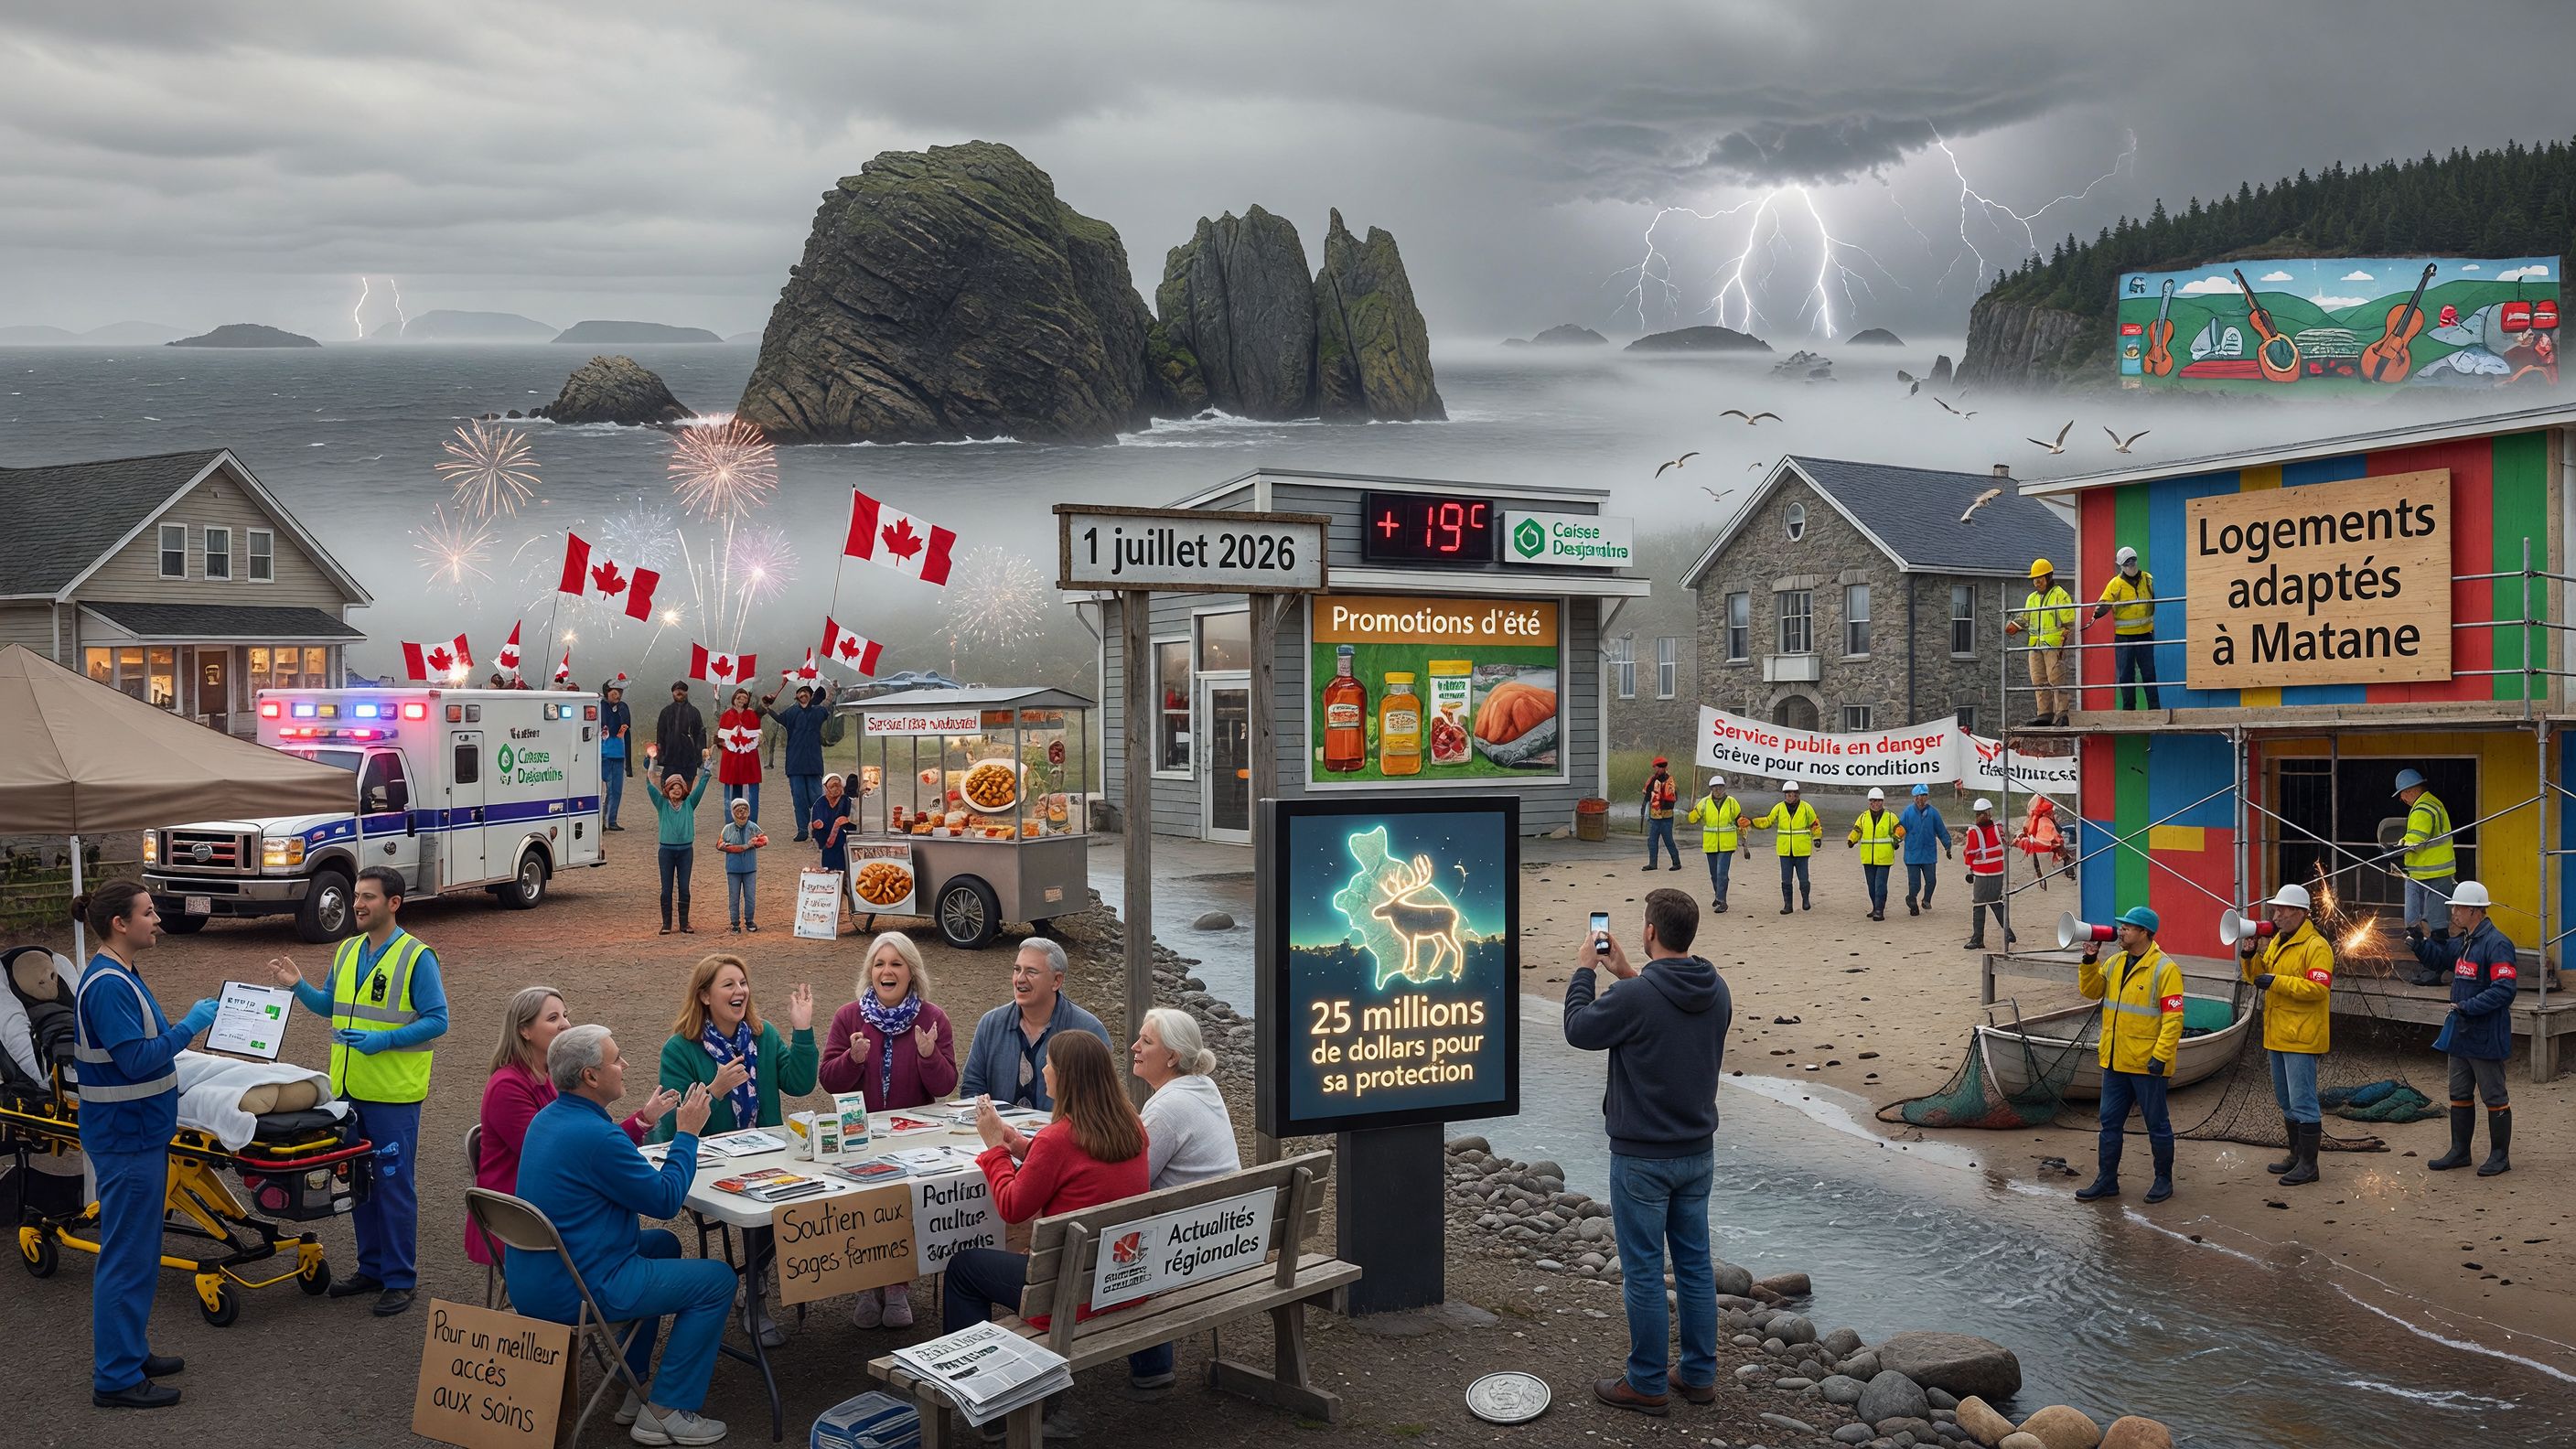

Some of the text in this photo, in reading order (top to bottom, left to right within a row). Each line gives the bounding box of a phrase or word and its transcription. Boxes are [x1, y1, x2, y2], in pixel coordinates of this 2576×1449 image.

[1084, 527, 1296, 575] 1 juillet 2026
[2199, 498, 2436, 564] Logements
[2227, 555, 2401, 617] adaptés
[1333, 606, 1540, 636] Promotions d'été
[2212, 622, 2420, 666] à Matane
[1713, 718, 1779, 747] Service
[1847, 742, 1872, 756] en
[1876, 733, 1945, 756] danger
[1712, 742, 1940, 777] Grève pour nos conditions
[1310, 994, 1485, 1035] 25 millions
[1311, 1035, 1485, 1065] de dollars pour
[1322, 1059, 1474, 1098] sa protection
[782, 1202, 904, 1244] Soutien aux
[1167, 1206, 1255, 1247] Actualités
[1165, 1234, 1259, 1275] régionales
[434, 1309, 560, 1366] Pour un meilleur
[434, 1387, 533, 1433] aux soins
